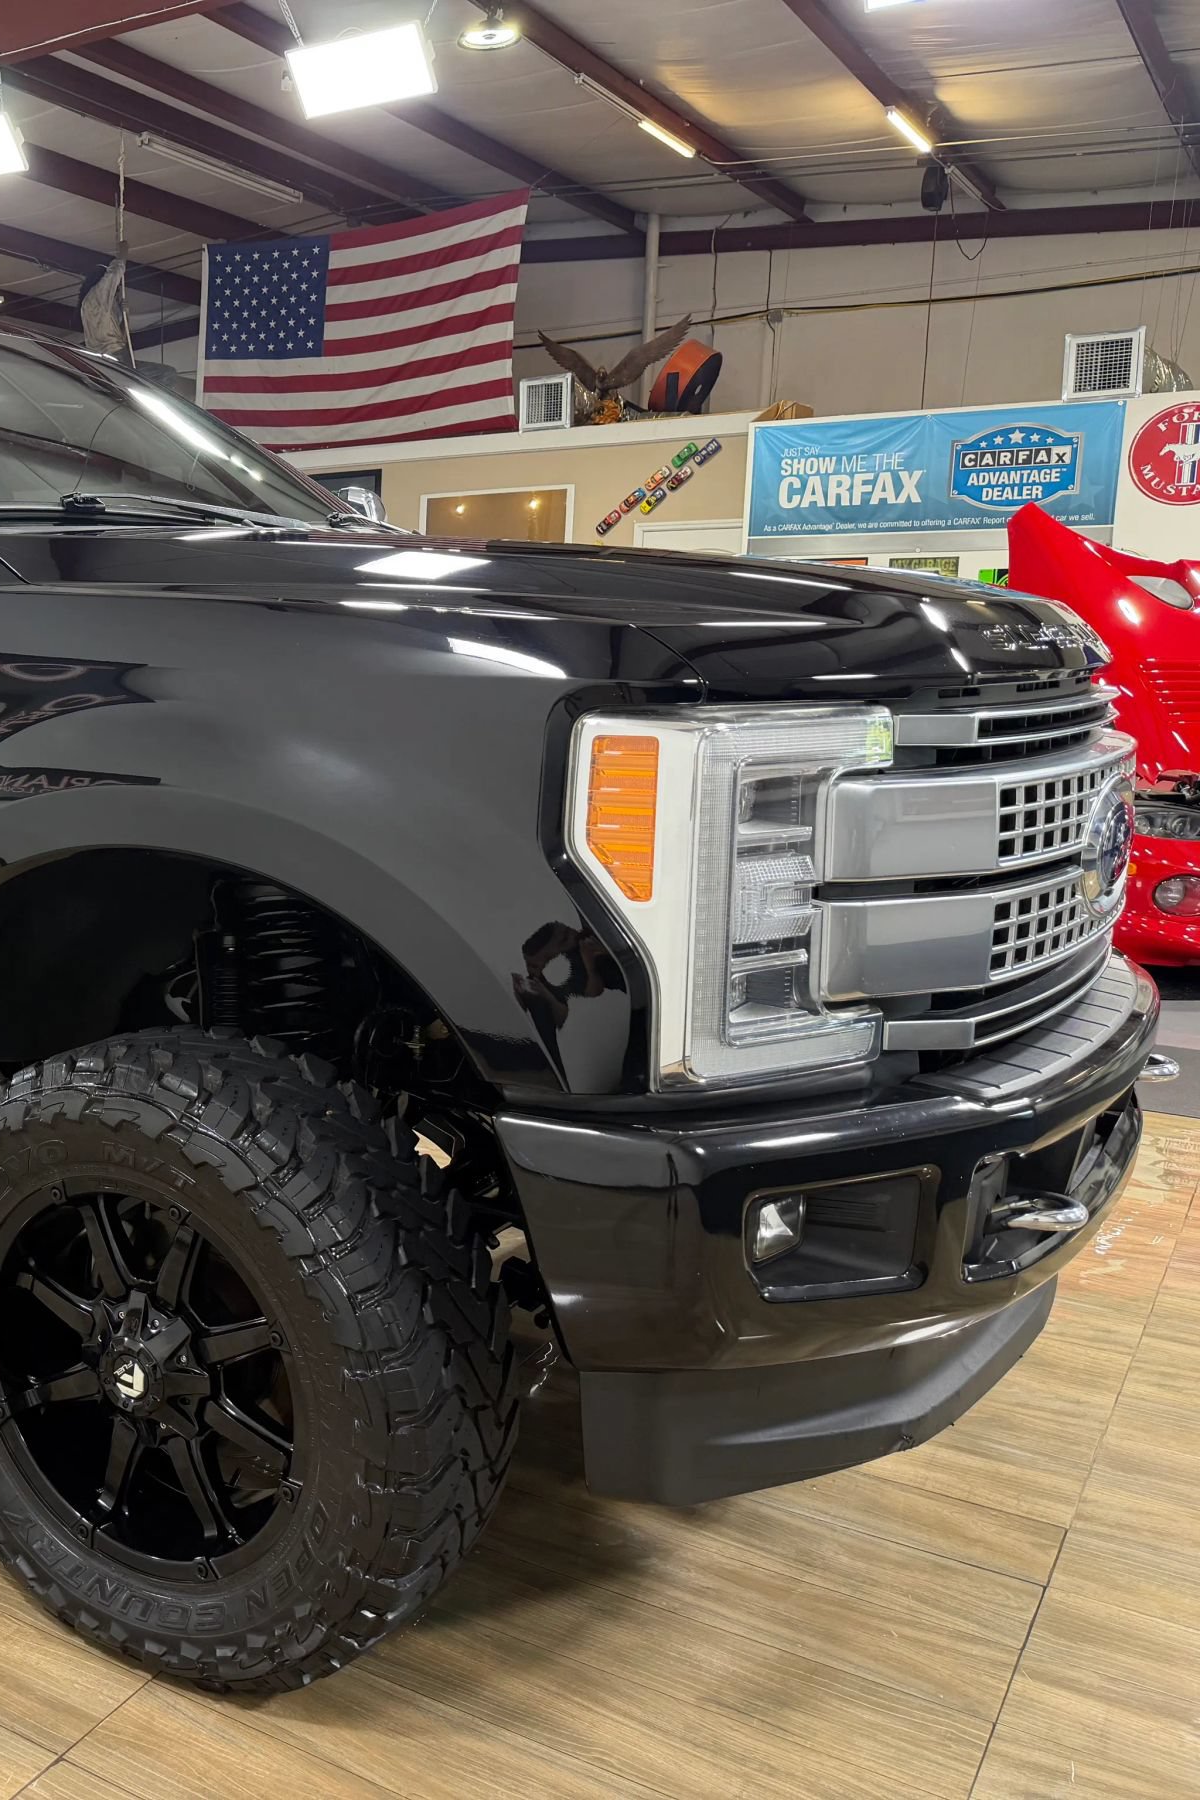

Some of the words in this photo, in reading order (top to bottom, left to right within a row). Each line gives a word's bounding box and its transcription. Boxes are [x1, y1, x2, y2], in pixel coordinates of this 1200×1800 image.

[781, 447, 802, 458] JUST
[803, 446, 820, 456] SAY
[963, 450, 1067, 467] CARFAX
[780, 456, 837, 476] SHOW
[841, 455, 867, 473] ME
[873, 452, 905, 471] THE
[778, 470, 922, 509] CARFAX
[982, 485, 1043, 501] DEALER
[778, 523, 801, 531] CARFAX
[879, 520, 912, 528] committed
[921, 519, 946, 528] offering
[983, 516, 1005, 525] Report
